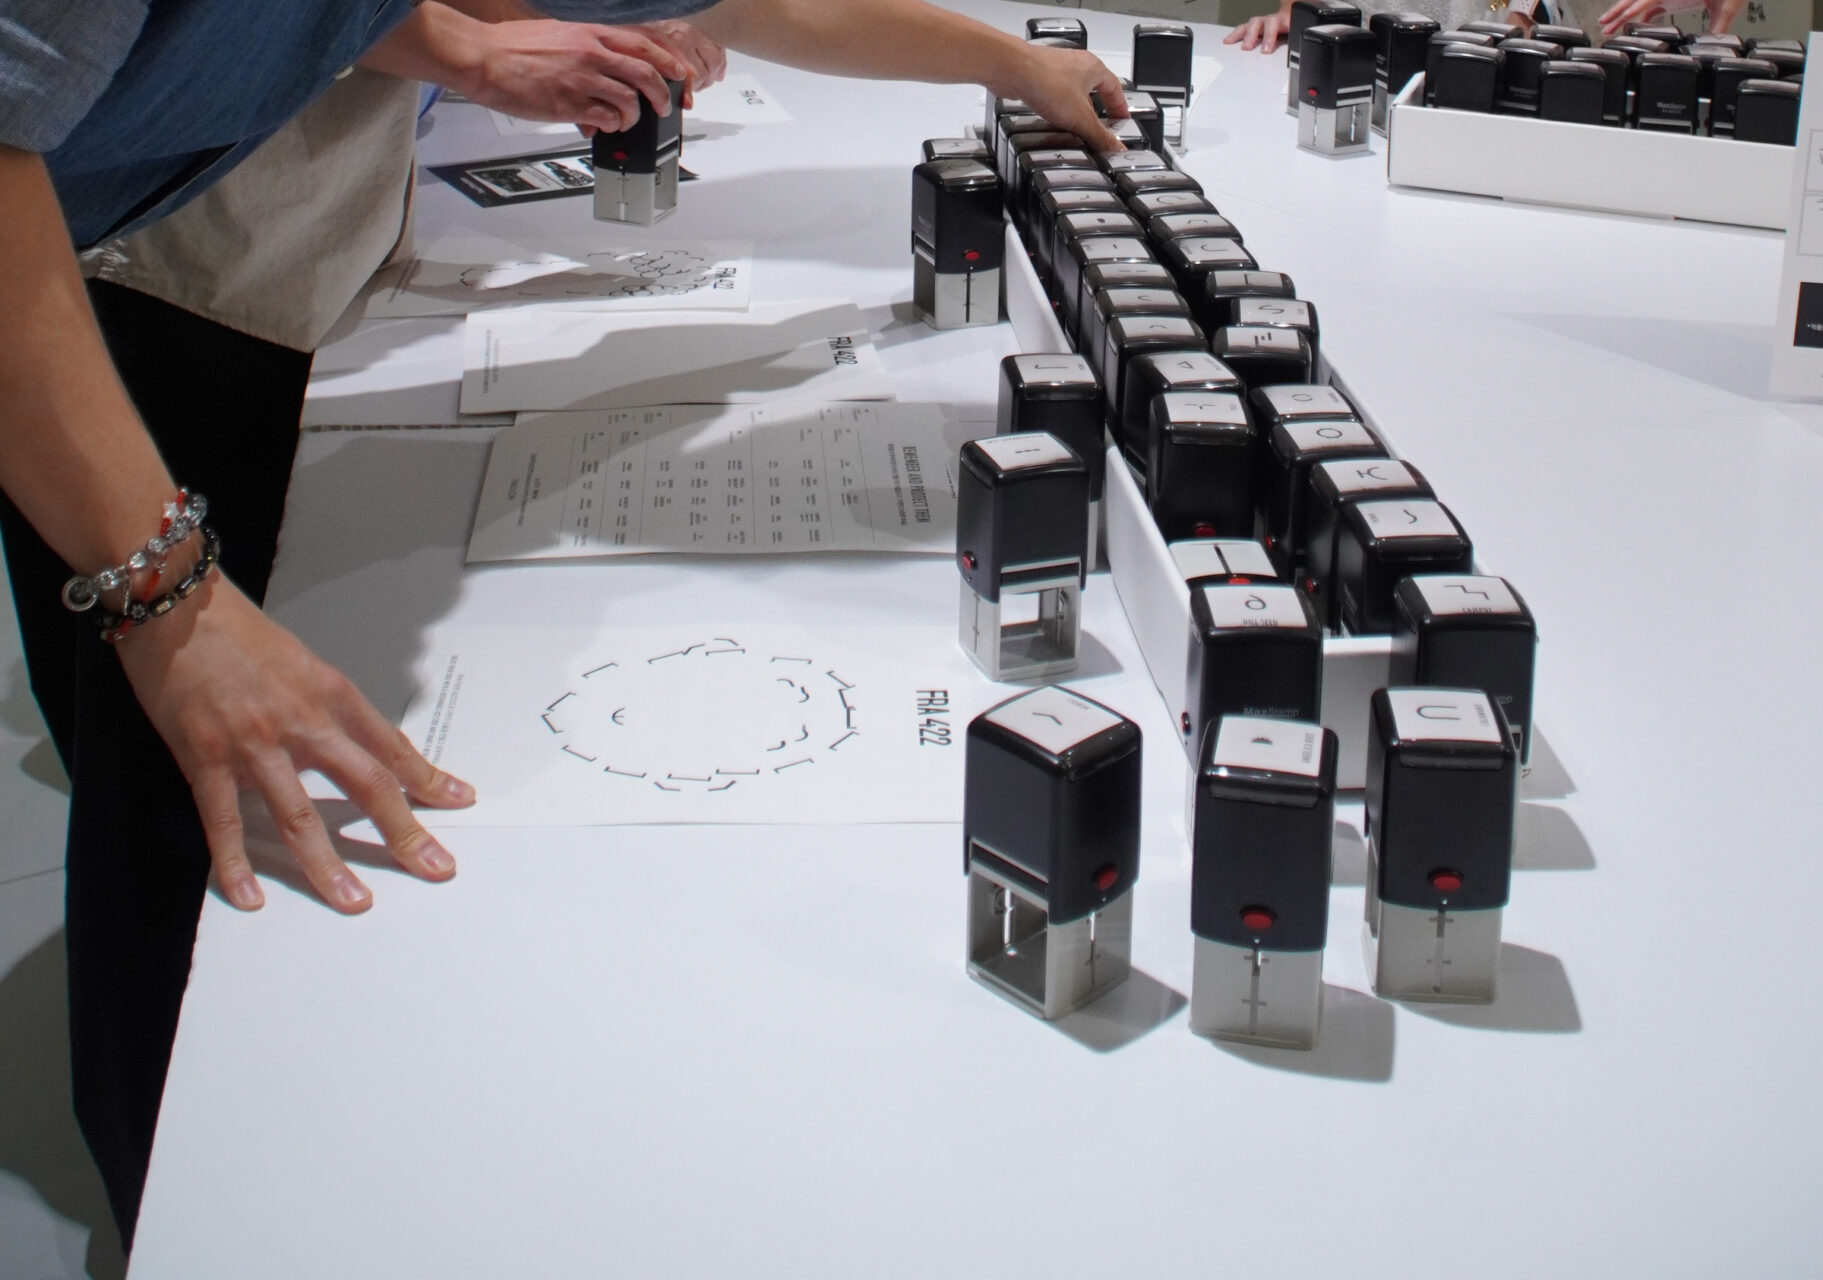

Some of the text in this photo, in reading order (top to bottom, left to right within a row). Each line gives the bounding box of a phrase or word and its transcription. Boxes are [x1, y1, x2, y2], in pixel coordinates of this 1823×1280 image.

[713, 267, 737, 291] FRA 422
[827, 336, 858, 366] FRA 422
[902, 446, 932, 523] REMEMBER AND PROTECT THEM
[916, 689, 952, 746] FRA 422
